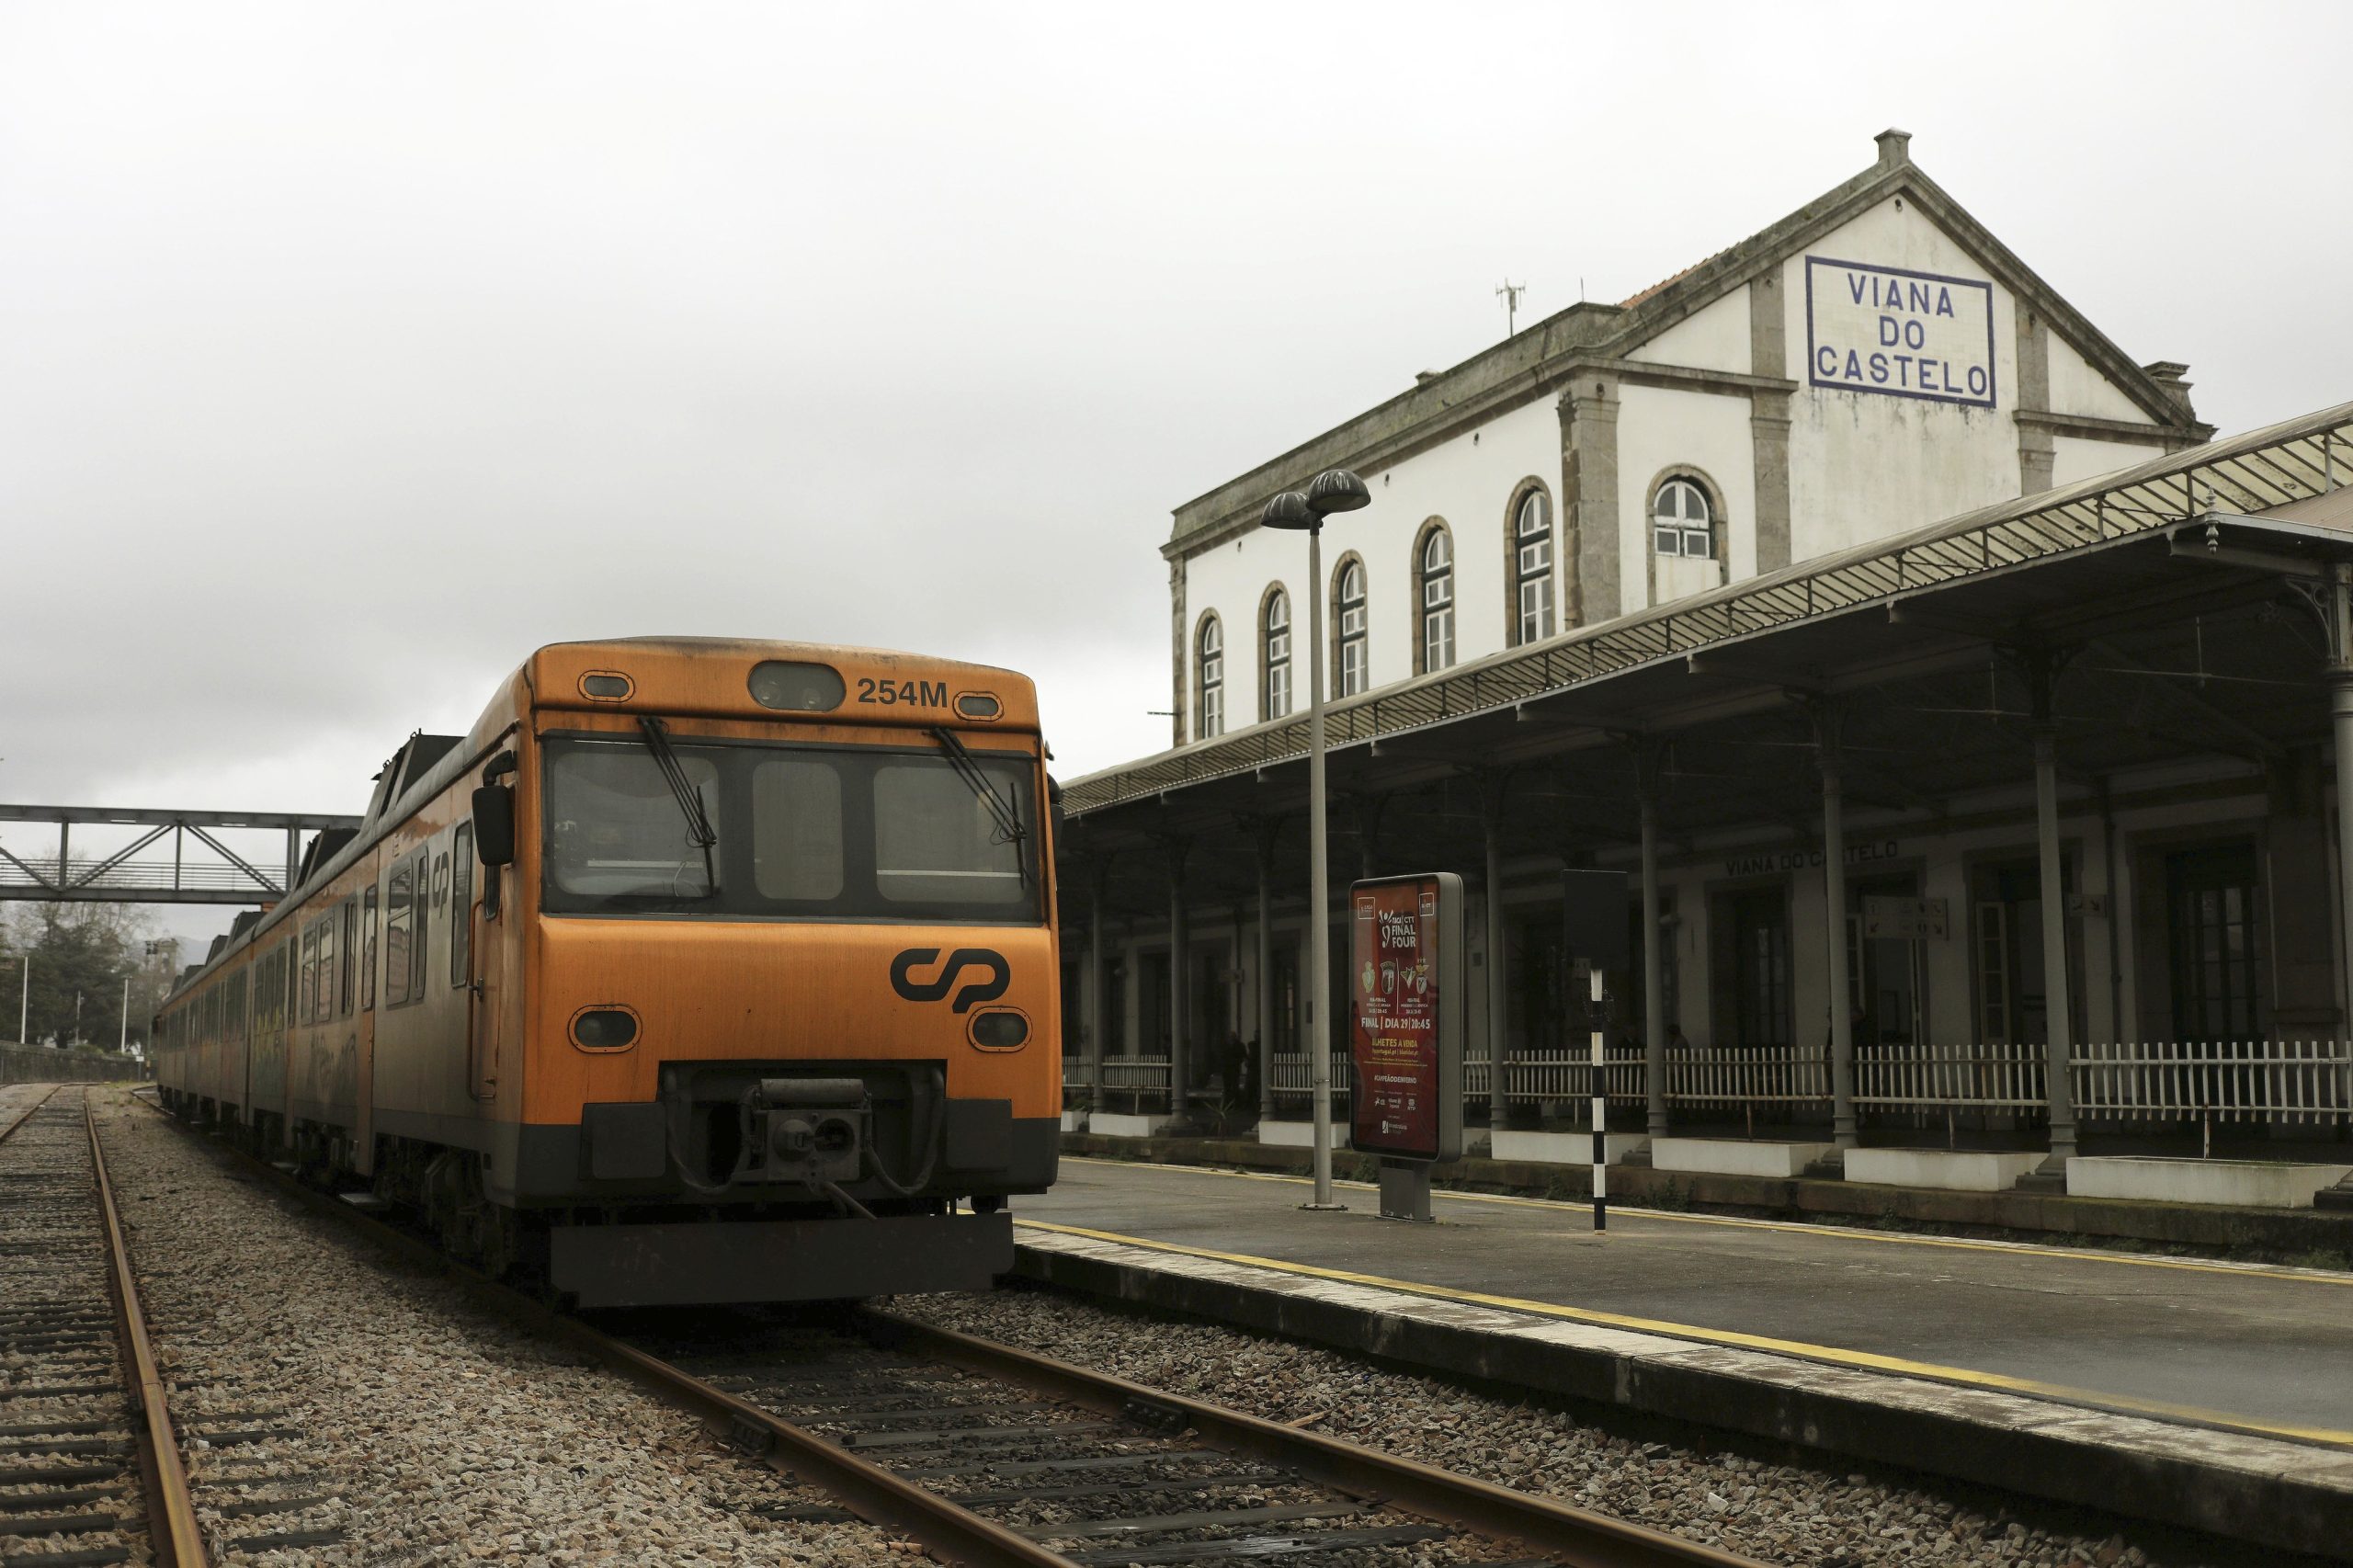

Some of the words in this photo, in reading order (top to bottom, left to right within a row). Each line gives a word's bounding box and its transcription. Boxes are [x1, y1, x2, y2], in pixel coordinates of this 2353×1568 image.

[1847, 272, 1955, 318] VIANA
[1879, 314, 1925, 350] DO
[1816, 346, 1987, 396] CASTELO
[858, 676, 948, 709] 254M
[1726, 855, 1774, 877] VIANA
[1780, 853, 1804, 869] DO
[1809, 841, 1898, 868] CTELO
[1392, 924, 1416, 936] FINAL
[1404, 915, 1415, 924] CTT
[1392, 936, 1416, 949] FOUR
[1361, 1017, 1379, 1028] FINAL
[1384, 1017, 1399, 1028] DIA
[1411, 1018, 1430, 1029] 20:45
